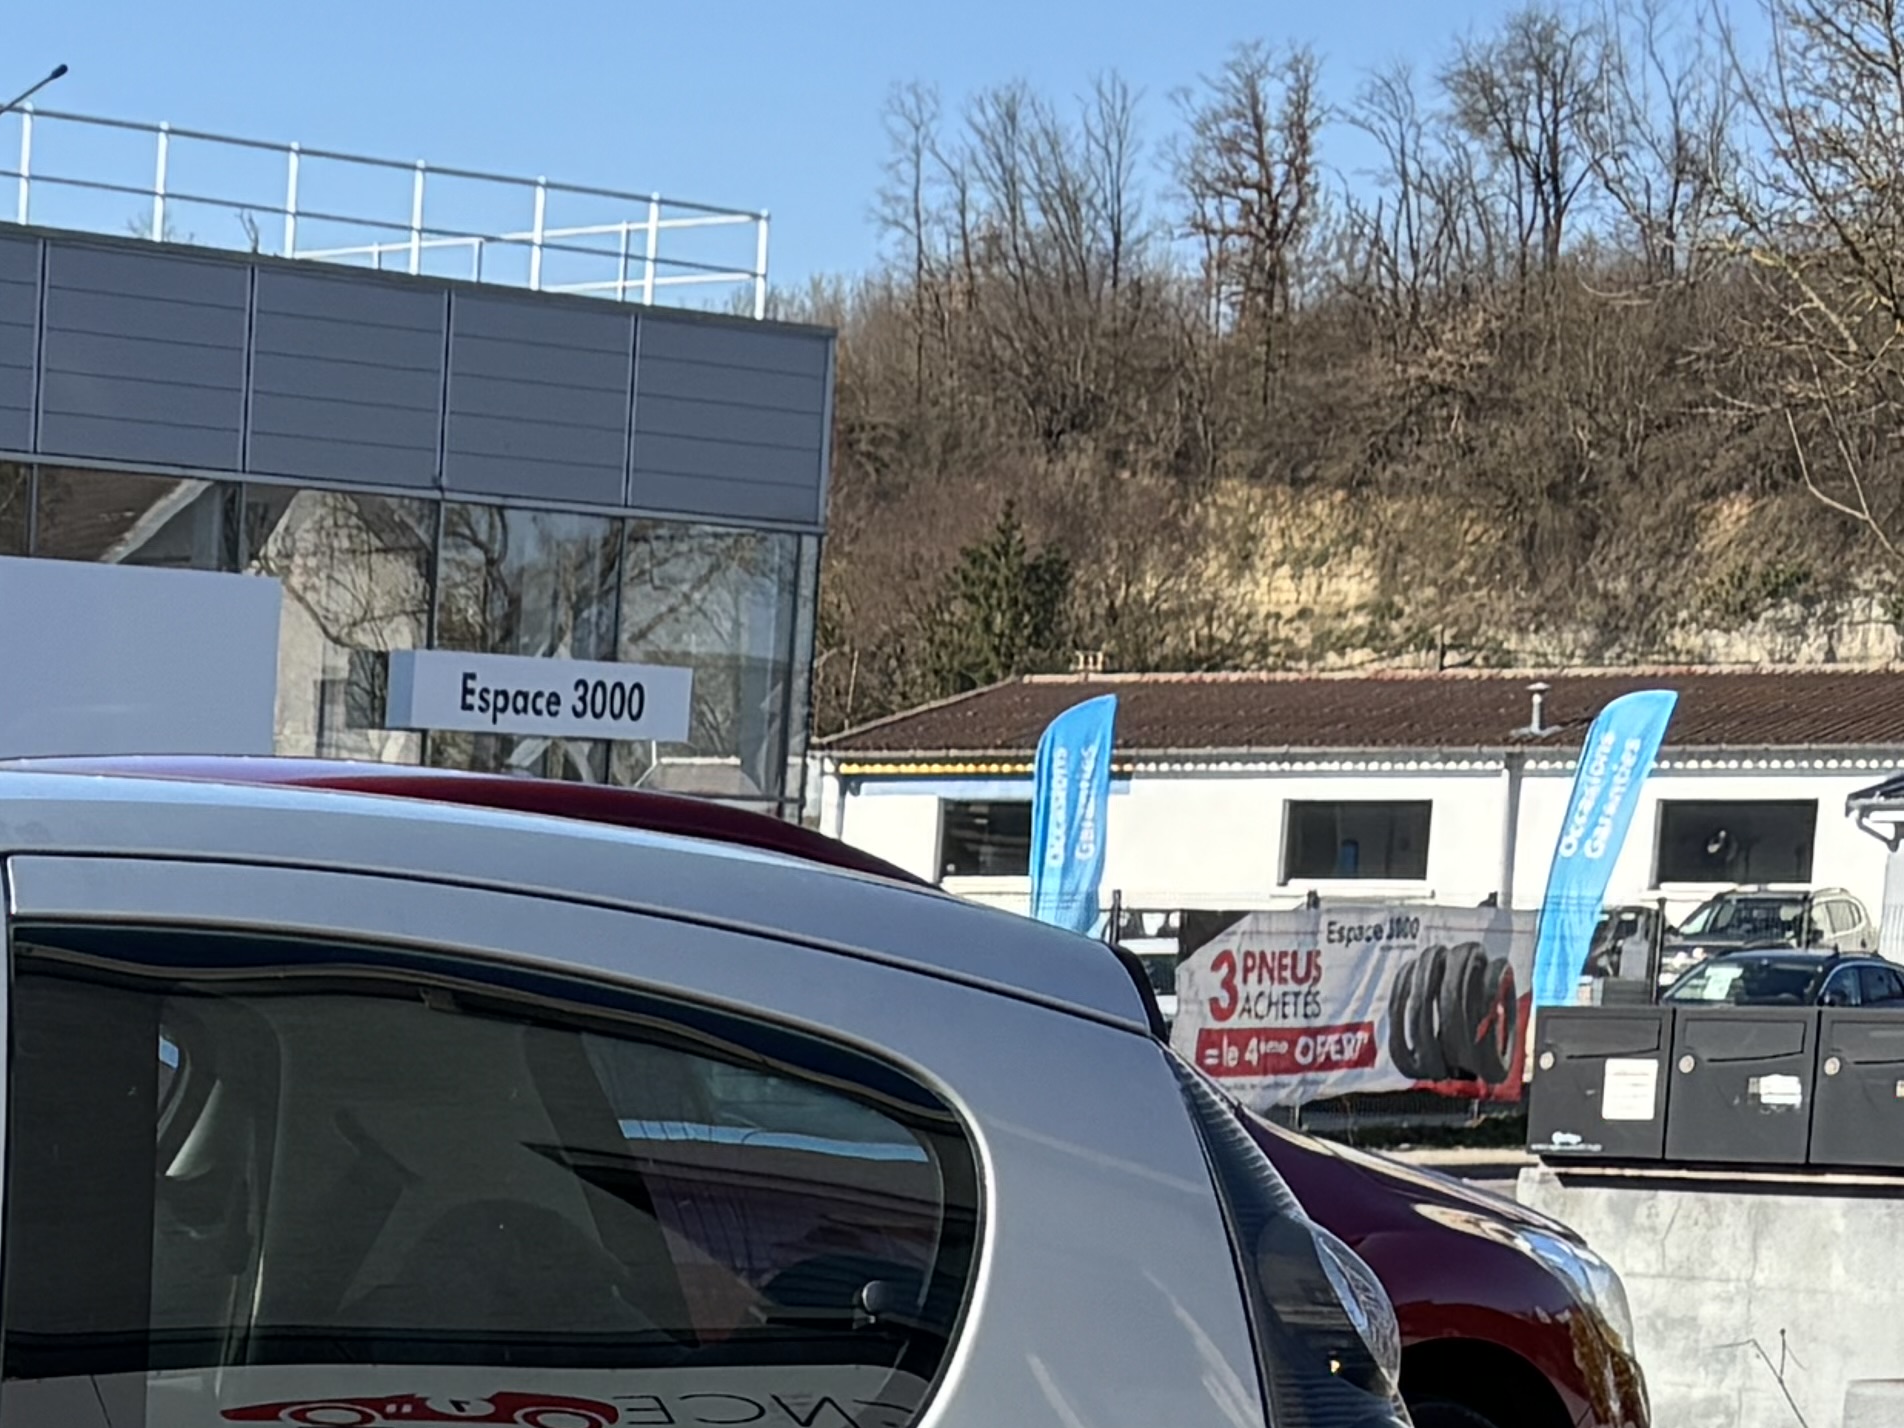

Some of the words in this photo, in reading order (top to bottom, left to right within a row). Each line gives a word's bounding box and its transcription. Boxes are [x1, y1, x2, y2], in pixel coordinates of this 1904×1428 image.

[460, 671, 562, 725] Espace
[571, 678, 646, 722] 3000
[1326, 920, 1385, 948] Espace
[1208, 949, 1239, 1022] 3
[1241, 947, 1323, 987] PNEUS
